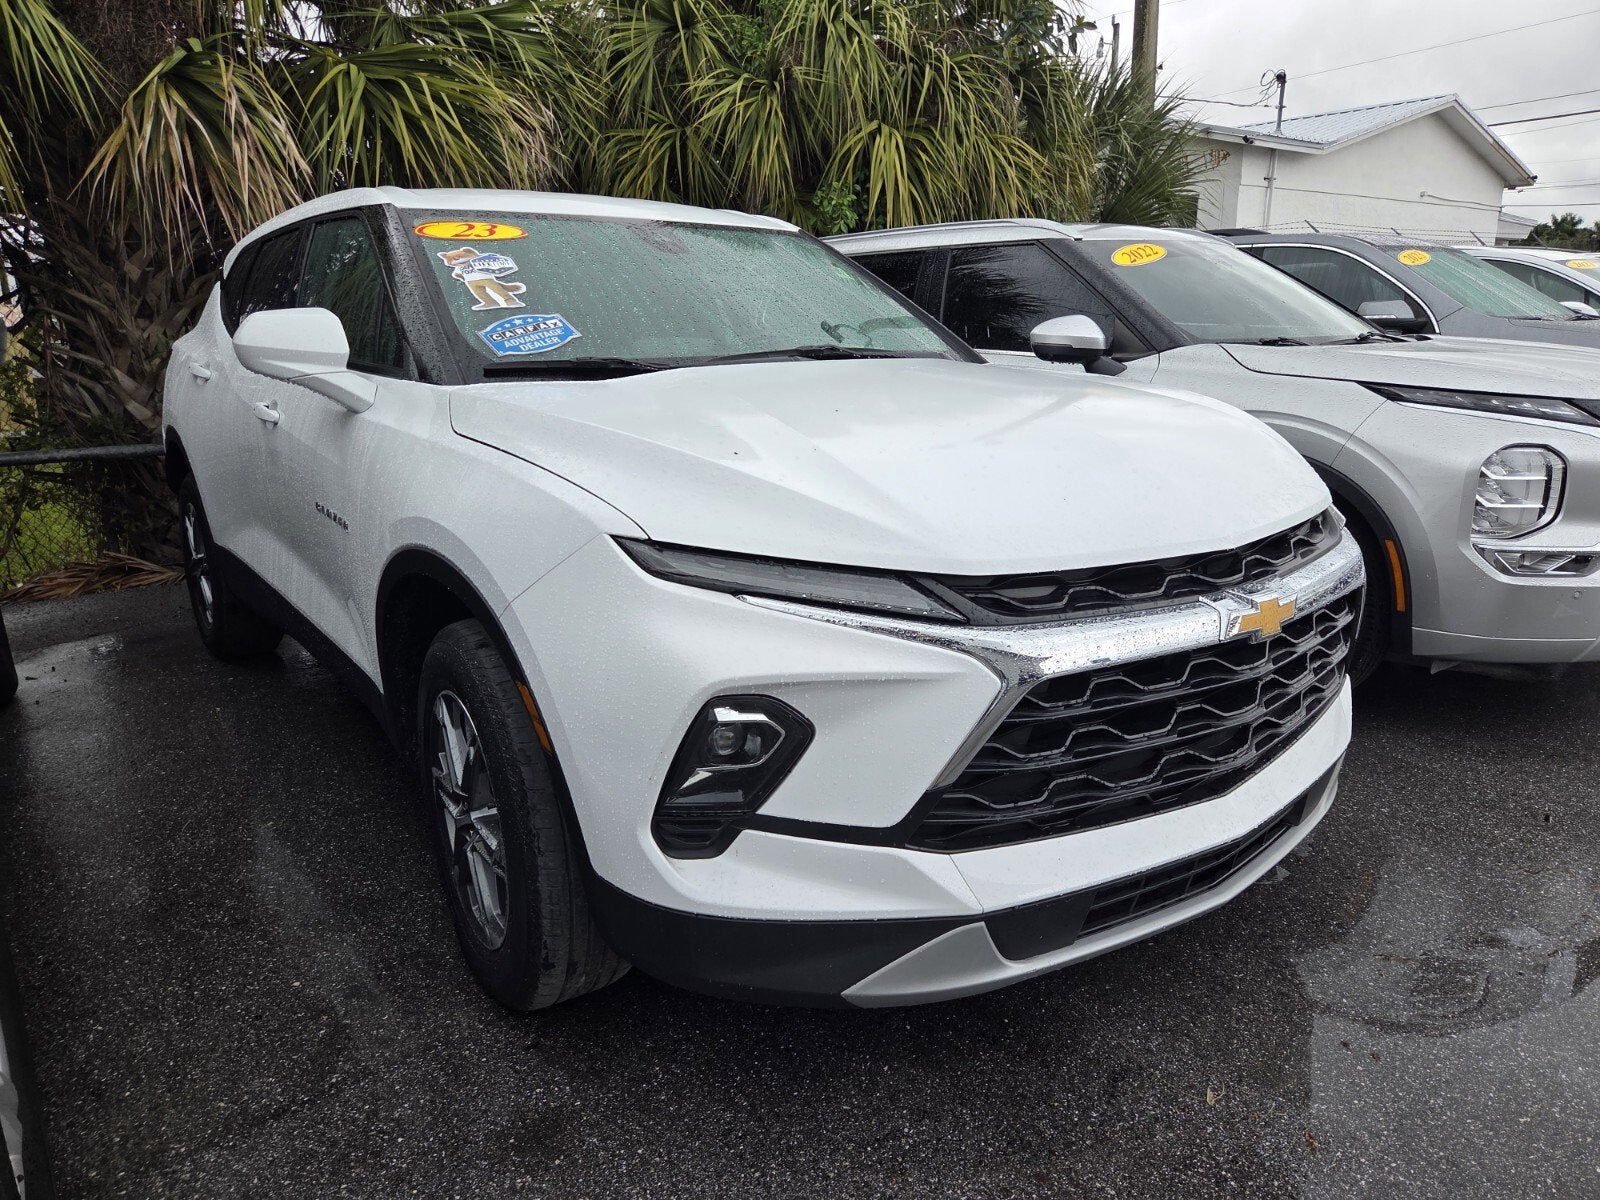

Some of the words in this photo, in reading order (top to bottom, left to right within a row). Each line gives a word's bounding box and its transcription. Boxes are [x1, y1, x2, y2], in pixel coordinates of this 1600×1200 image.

[451, 223, 498, 237] 23
[1121, 245, 1158, 263] 2022
[490, 320, 562, 341] CARFAX
[504, 328, 564, 348] ADVANTAGE
[519, 336, 561, 351] DEALER
